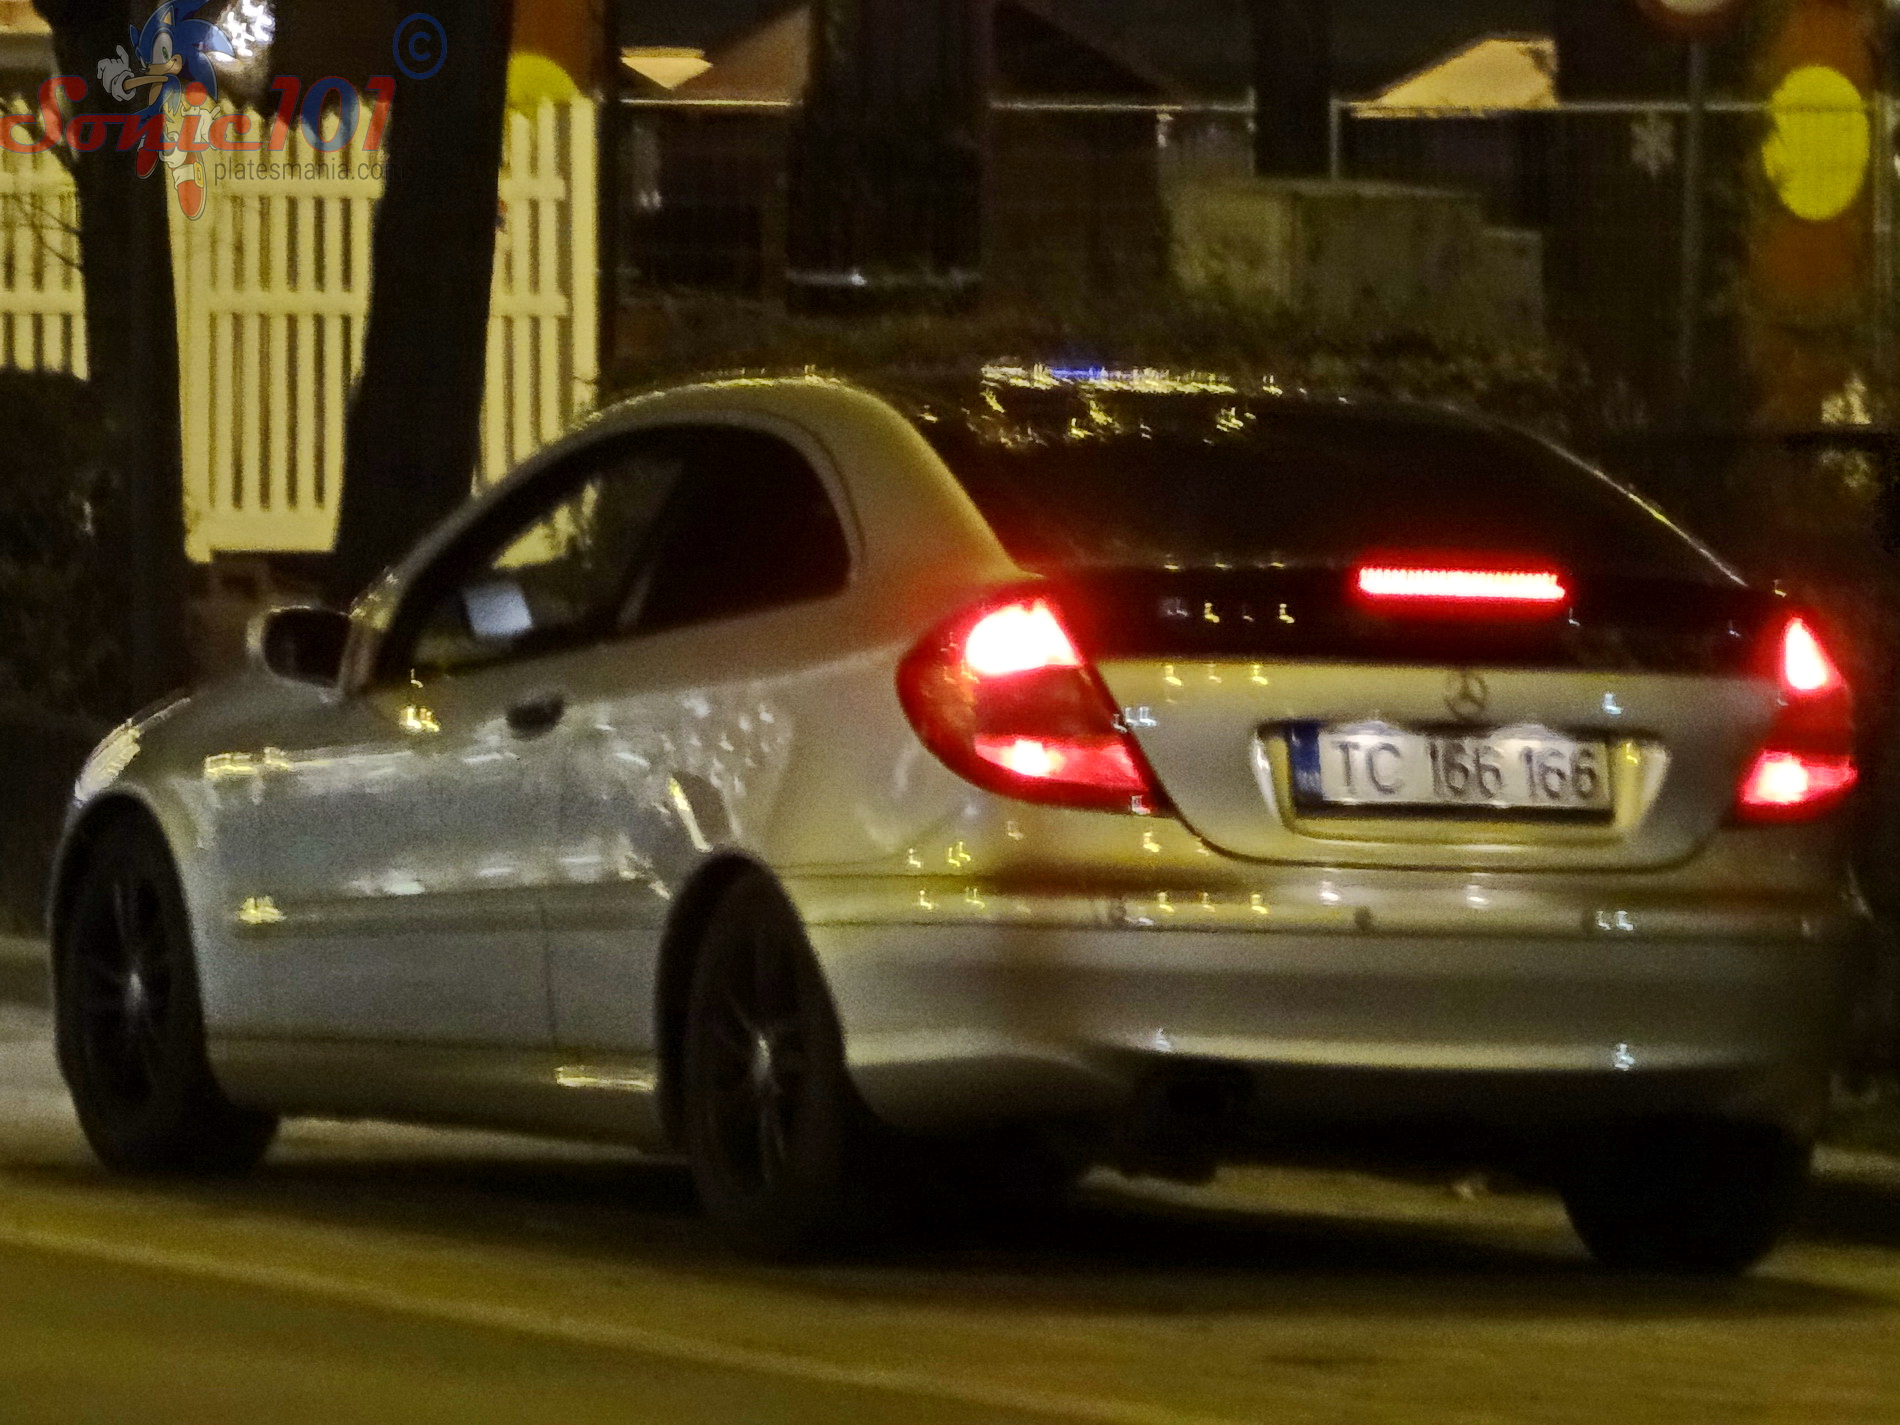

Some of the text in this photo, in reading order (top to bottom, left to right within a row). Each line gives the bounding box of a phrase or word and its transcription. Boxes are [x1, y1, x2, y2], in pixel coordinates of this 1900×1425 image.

[1333, 741, 1598, 800] TC 166 166
